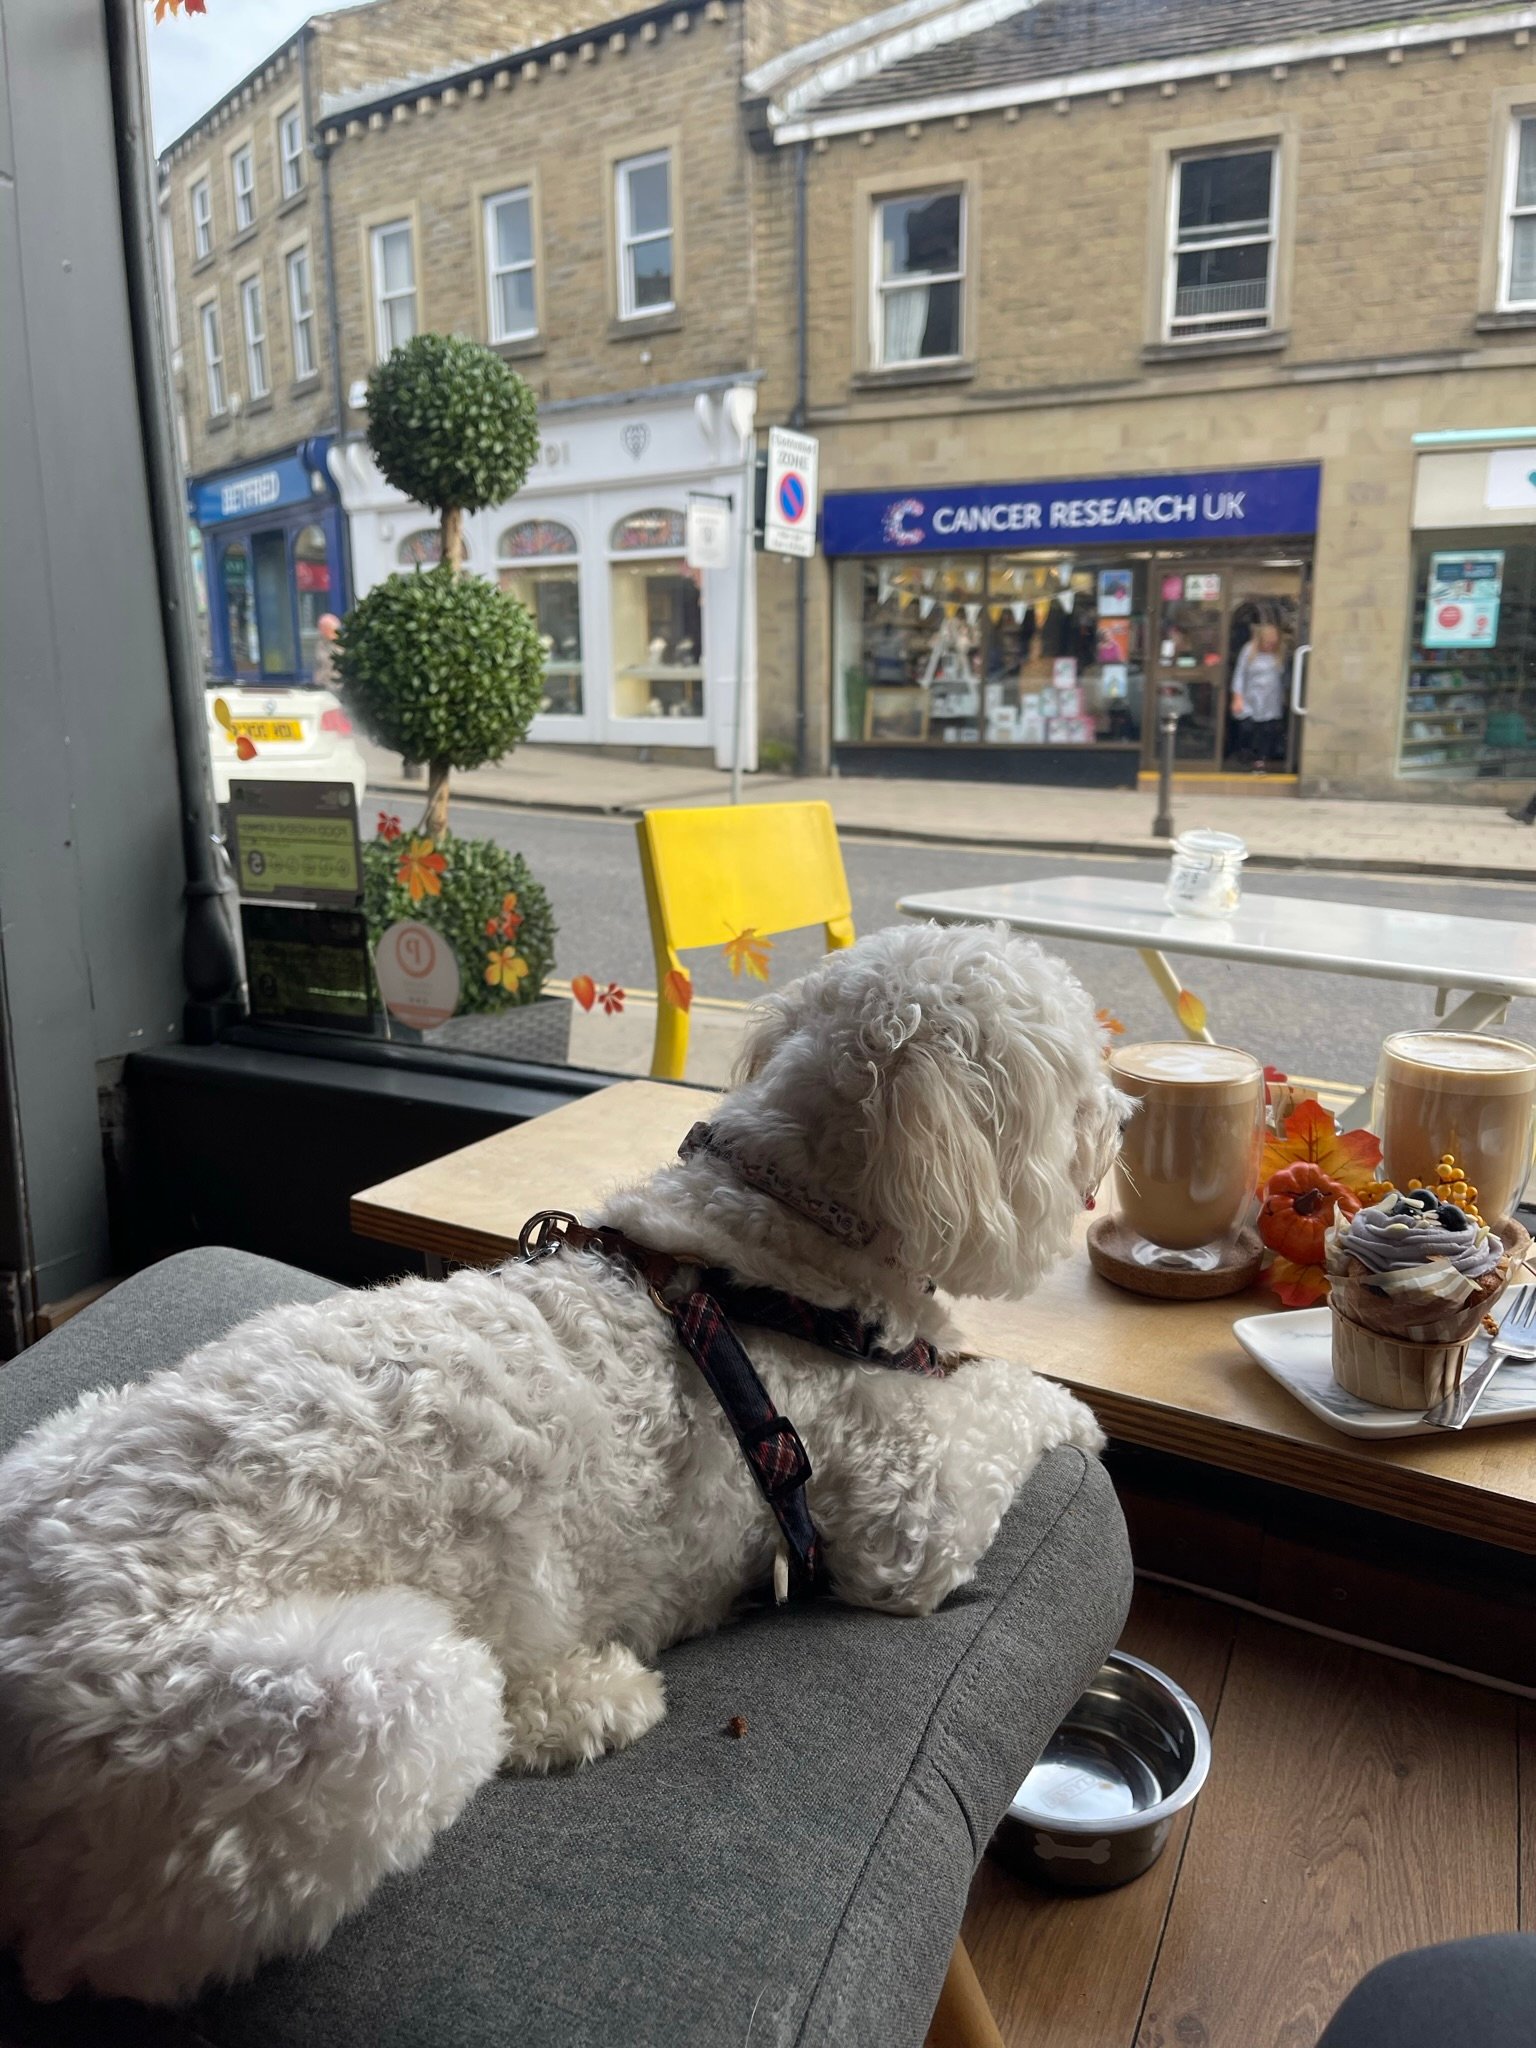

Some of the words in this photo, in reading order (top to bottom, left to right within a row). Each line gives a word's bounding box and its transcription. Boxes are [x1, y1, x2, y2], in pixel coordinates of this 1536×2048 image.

[222, 470, 280, 515] BETFRED
[932, 503, 1042, 535] CANCER
[1049, 494, 1197, 530] RESEARCH
[1202, 490, 1246, 522] UK
